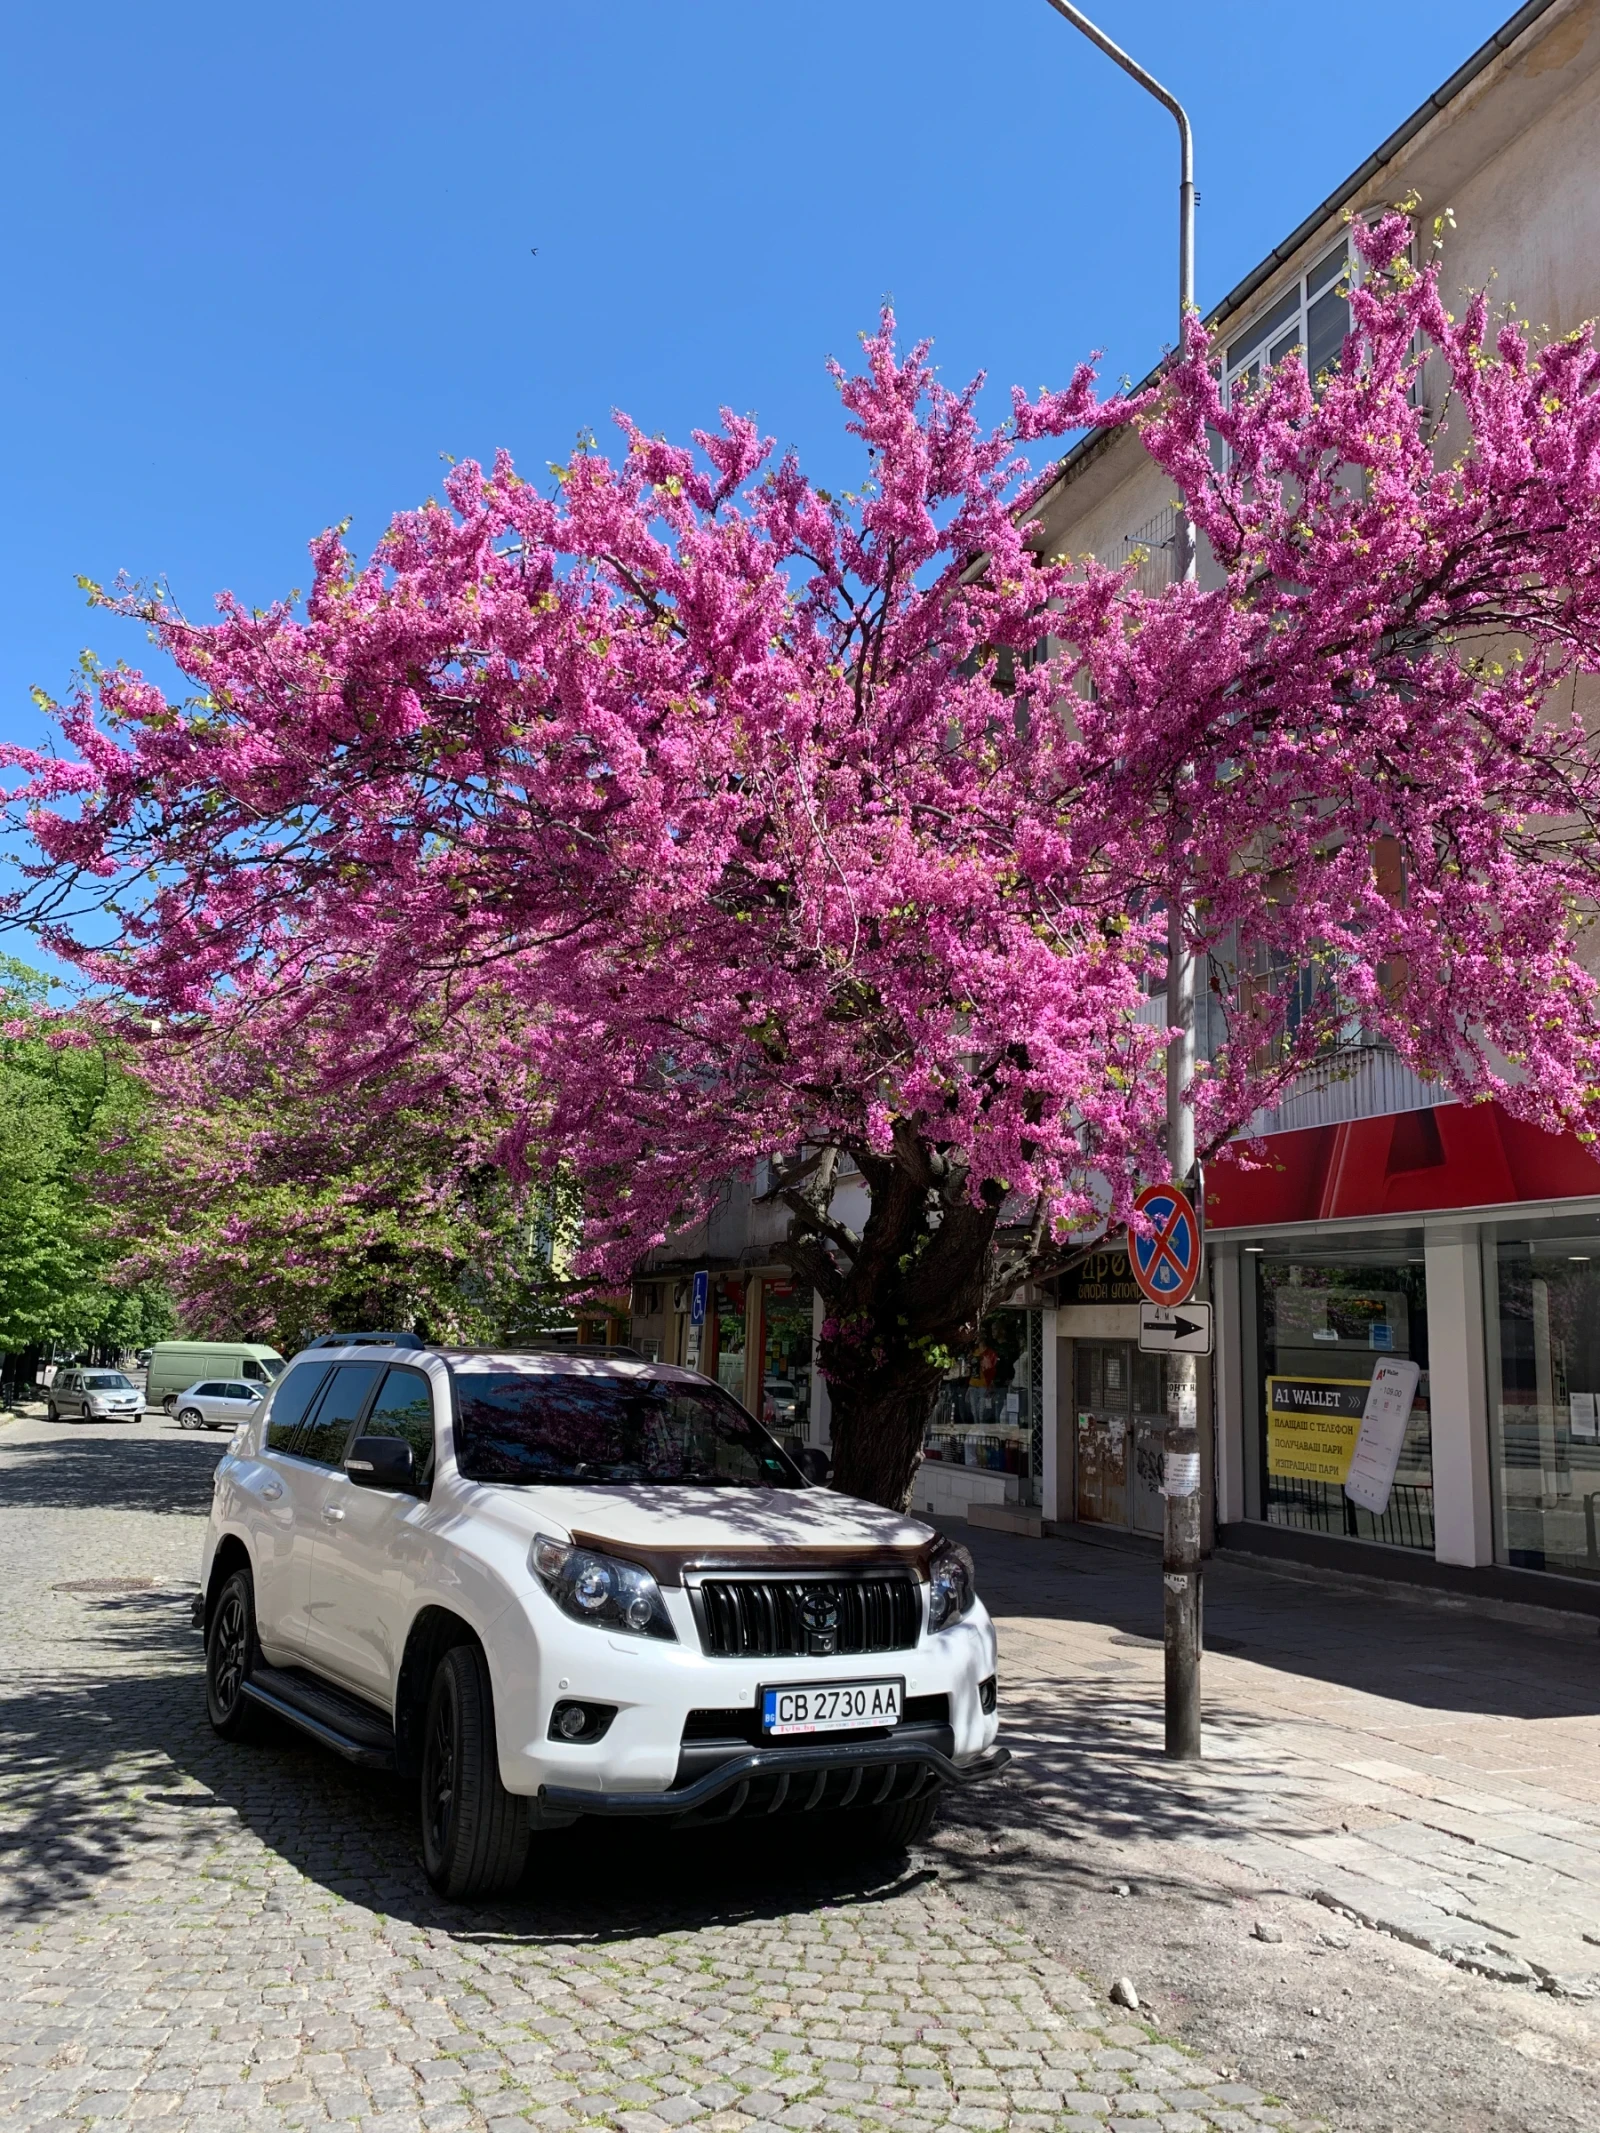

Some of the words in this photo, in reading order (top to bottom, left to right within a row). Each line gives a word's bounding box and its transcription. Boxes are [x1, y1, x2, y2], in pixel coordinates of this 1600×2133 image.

[1154, 1308, 1160, 1321] 4
[1167, 1383, 1187, 1392] ОНТ
[1275, 1388, 1290, 1403] A1
[1292, 1389, 1341, 1407] WALLET
[1274, 1418, 1308, 1431] ПЛАЩАШ
[1309, 1422, 1315, 1431] С
[1316, 1422, 1354, 1435] ТЕЛЕФОН
[1274, 1438, 1320, 1452] ПОЛУЧАВАШ
[1322, 1444, 1343, 1455] ПАРИ
[1275, 1459, 1317, 1472] ИЗПРАЩАШ
[1318, 1464, 1339, 1475] ПАРИ
[779, 1694, 809, 1722] CB
[814, 1690, 866, 1720] 2730
[871, 1687, 897, 1715] AA
[765, 1713, 775, 1723] BG
